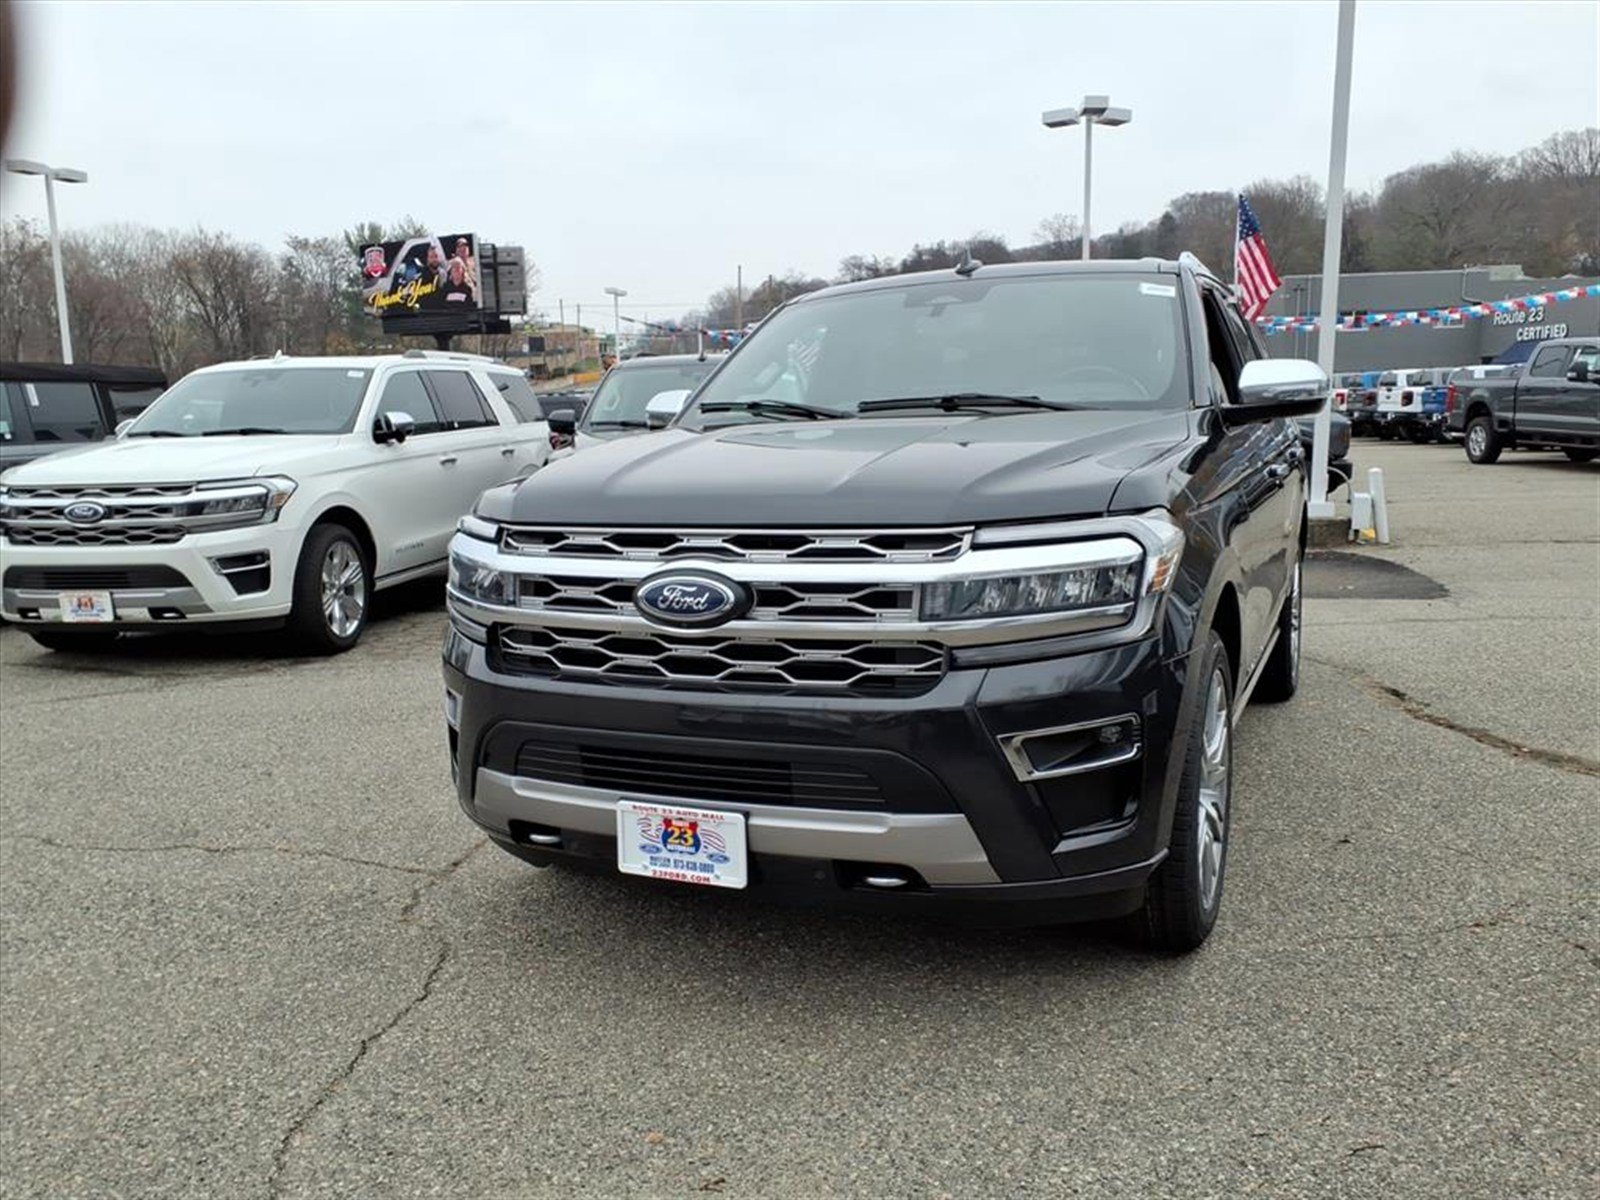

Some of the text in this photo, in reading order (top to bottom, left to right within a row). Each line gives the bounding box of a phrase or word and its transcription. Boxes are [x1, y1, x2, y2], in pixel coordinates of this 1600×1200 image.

[1493, 306, 1544, 325] Route 23
[1516, 323, 1568, 341] CERTIFIED
[657, 584, 709, 610] Ford
[667, 826, 695, 846] 23
